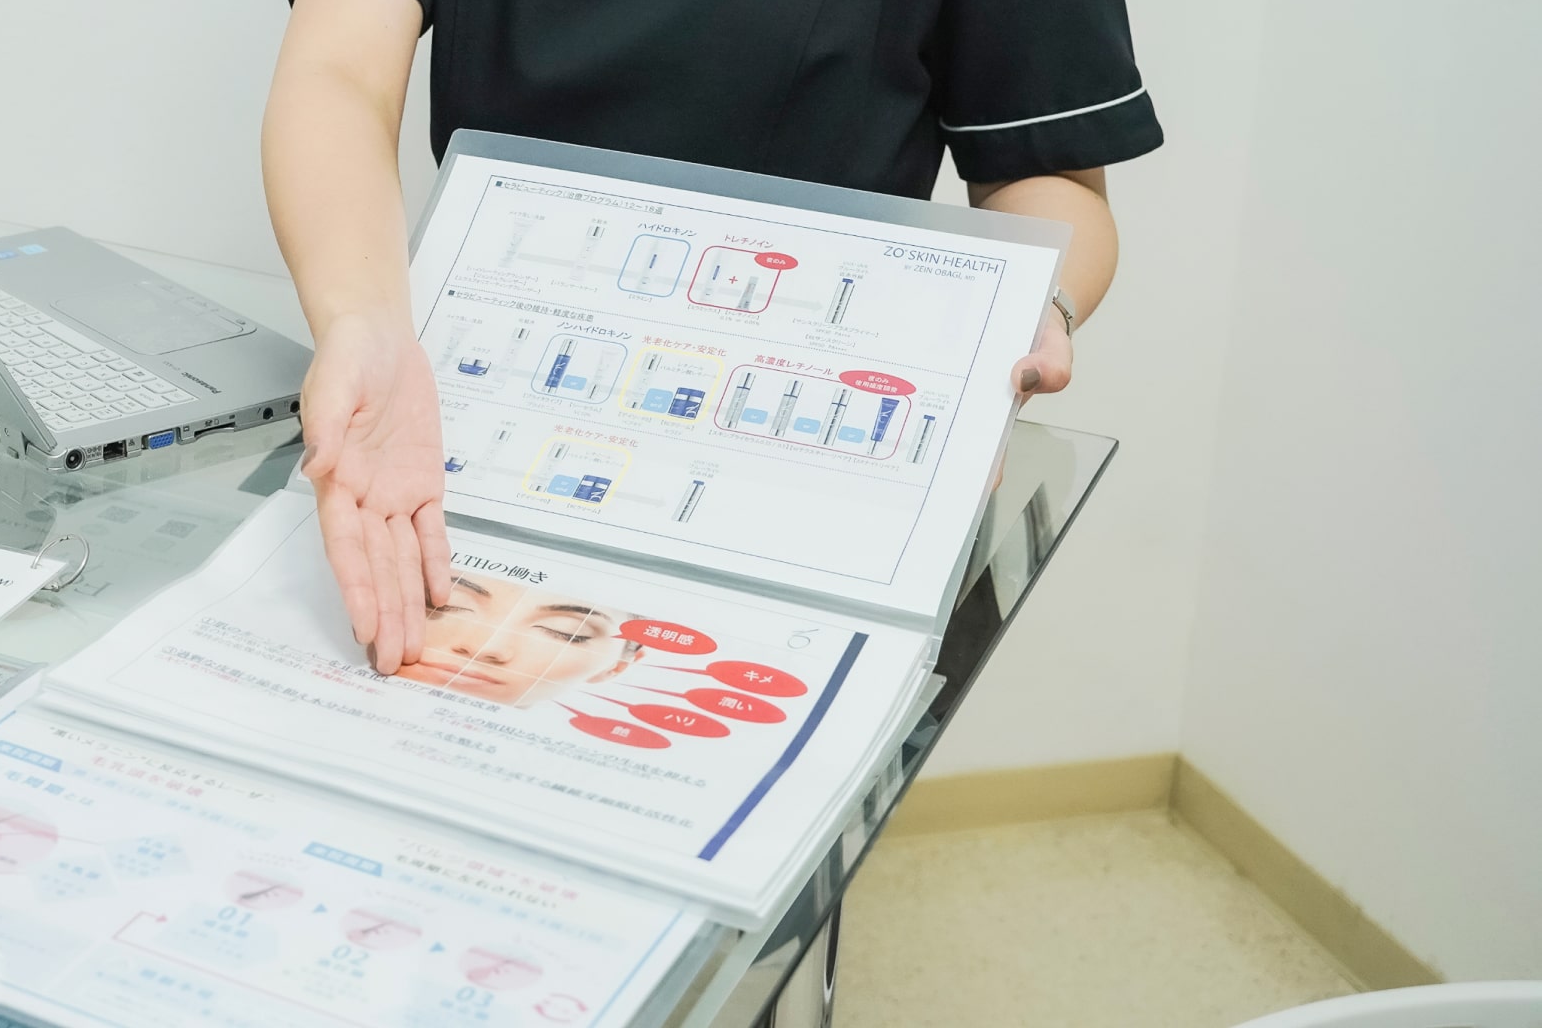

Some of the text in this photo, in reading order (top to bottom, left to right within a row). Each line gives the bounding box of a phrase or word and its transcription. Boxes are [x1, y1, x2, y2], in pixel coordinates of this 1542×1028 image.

[636, 220, 698, 238] ハイドロキノン
[722, 233, 775, 250] トレチノイン
[908, 250, 940, 265] SKIN
[943, 255, 999, 275] HEALTH
[913, 265, 933, 275] ZEIN
[555, 319, 633, 342] ノンハイドロキノン
[640, 333, 729, 358] 光老化ケア・安定化
[752, 353, 835, 377] 高濃度レチノール
[553, 423, 640, 449] 光老化ケア・安定化
[643, 625, 695, 647] 透明感
[743, 670, 773, 684] キメ
[718, 696, 753, 711] 潤い
[664, 714, 696, 727] ハリ
[218, 906, 252, 925] 01
[332, 944, 370, 963] 02
[456, 986, 495, 1009] 03
